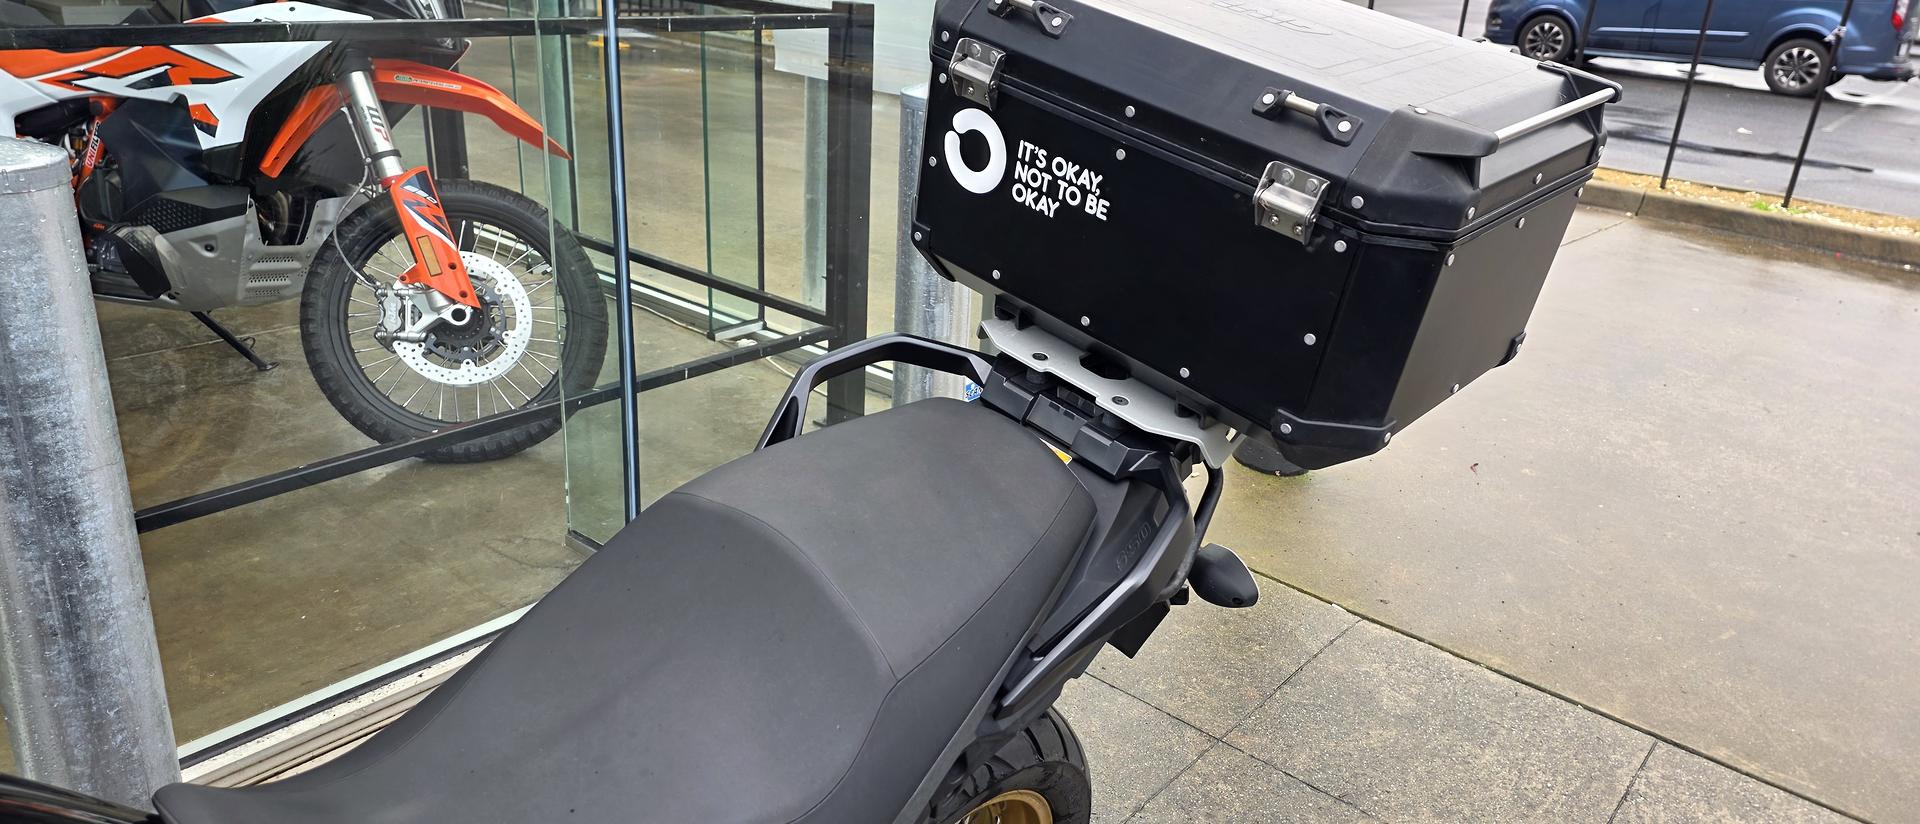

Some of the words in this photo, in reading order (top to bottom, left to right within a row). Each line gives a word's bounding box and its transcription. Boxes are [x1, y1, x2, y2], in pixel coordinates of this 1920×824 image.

[1014, 160, 1053, 193] NOT
[1057, 179, 1082, 206] TO
[1084, 193, 1111, 221] BE
[1017, 139, 1048, 169] IT'S
[1051, 156, 1103, 197] OKAY,
[1011, 182, 1060, 218] OKAY
